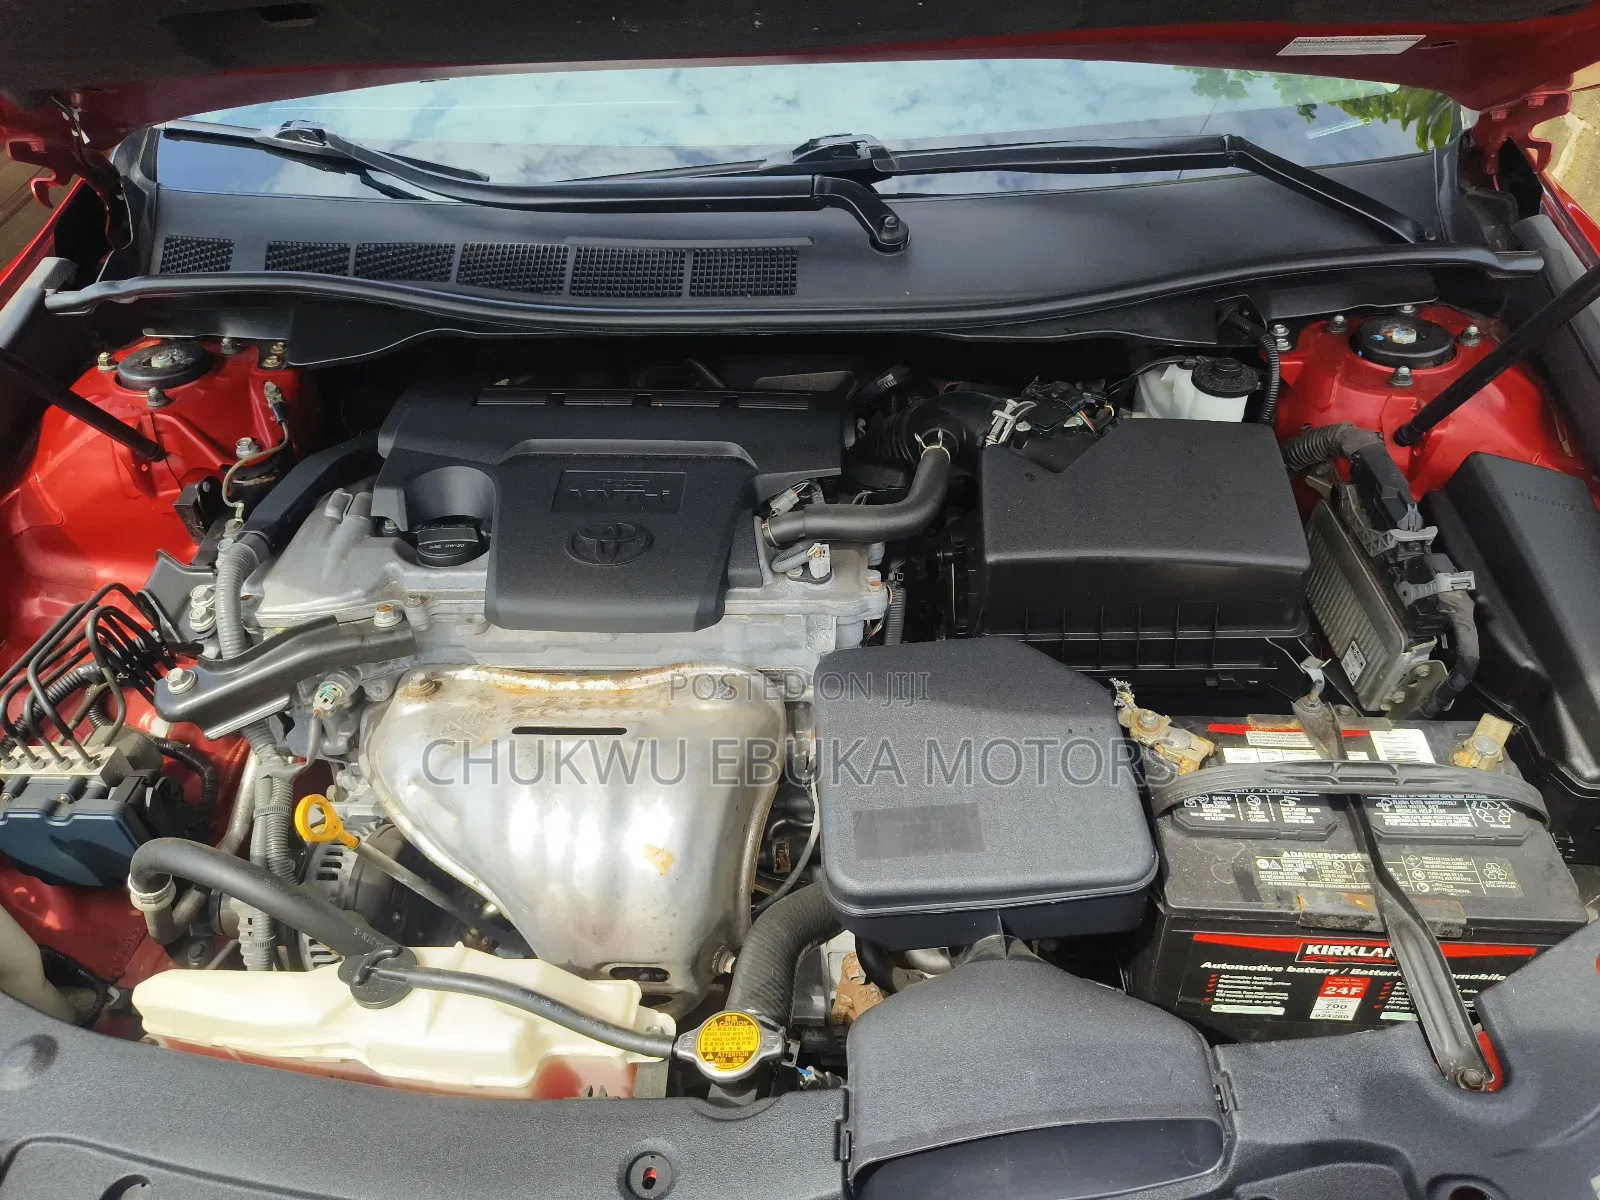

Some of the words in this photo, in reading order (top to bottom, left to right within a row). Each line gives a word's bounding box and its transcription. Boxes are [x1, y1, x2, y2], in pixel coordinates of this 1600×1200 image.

[1200, 961, 1284, 973] Automotive
[1286, 964, 1340, 975] battery
[1452, 973, 1507, 981] omobile
[1324, 985, 1364, 996] 24F
